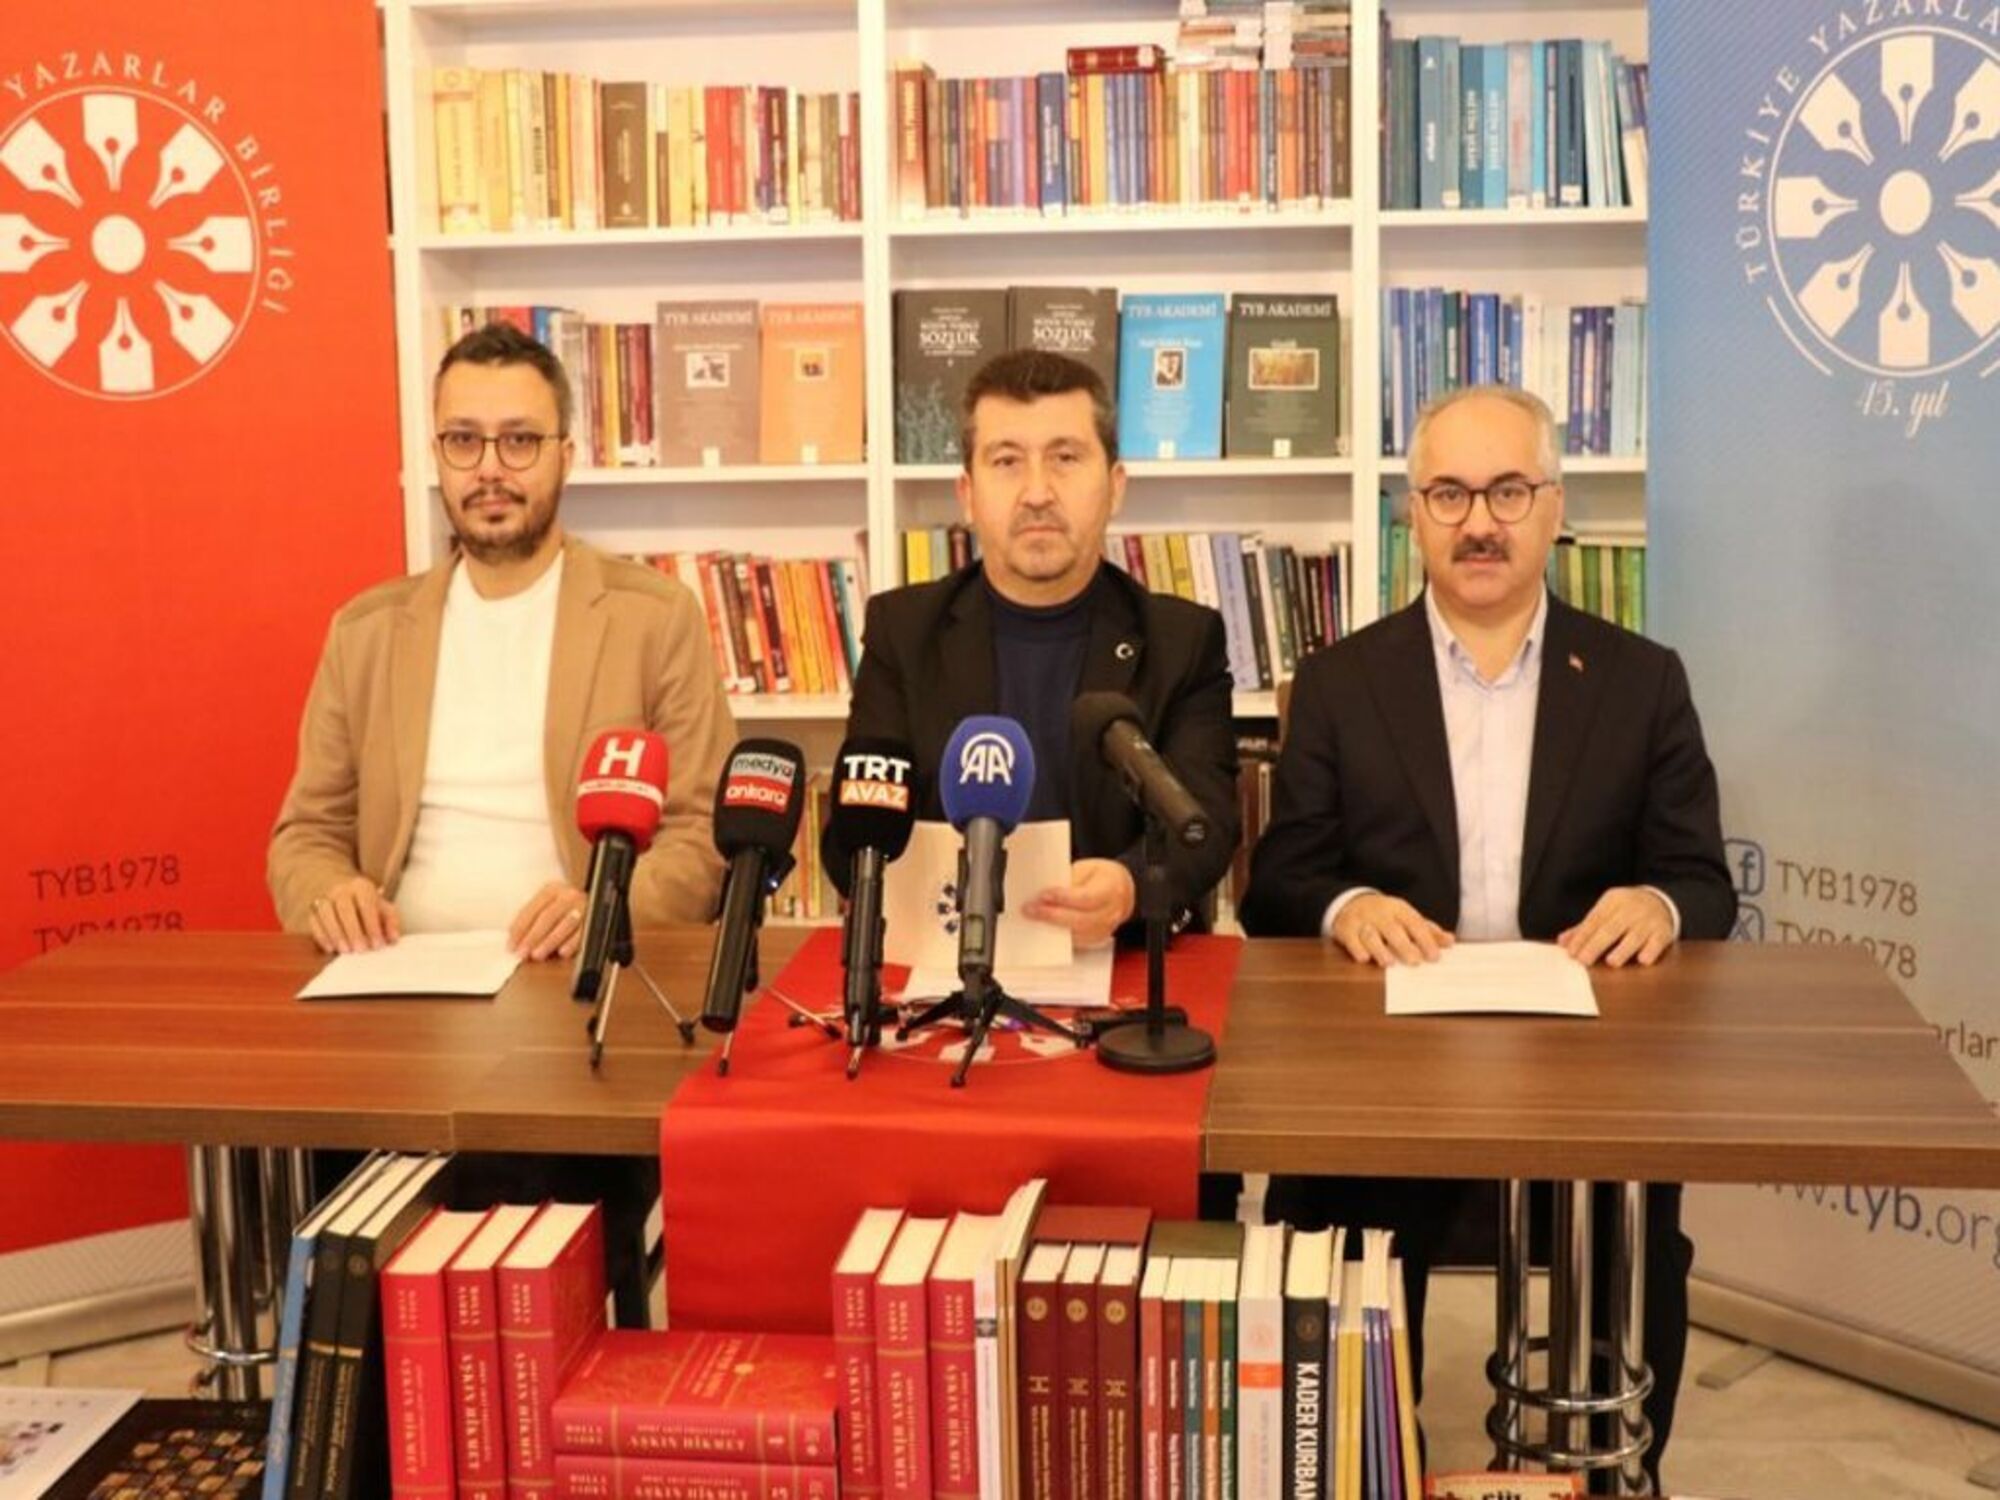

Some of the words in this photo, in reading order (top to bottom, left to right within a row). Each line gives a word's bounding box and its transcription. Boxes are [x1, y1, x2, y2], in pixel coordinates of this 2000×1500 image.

[4, 50, 227, 123] YAZARLAR
[1240, 302, 1267, 318] TYB
[1267, 302, 1332, 317] AKADEMİ
[598, 738, 646, 777] H
[844, 754, 911, 784] TRT
[960, 745, 1012, 785] AA
[726, 784, 788, 805] ankara
[843, 784, 908, 807] AVAZ
[29, 854, 181, 901] TYB1978
[1776, 860, 1918, 917] TYB1978
[1295, 1362, 1321, 1426] KADER
